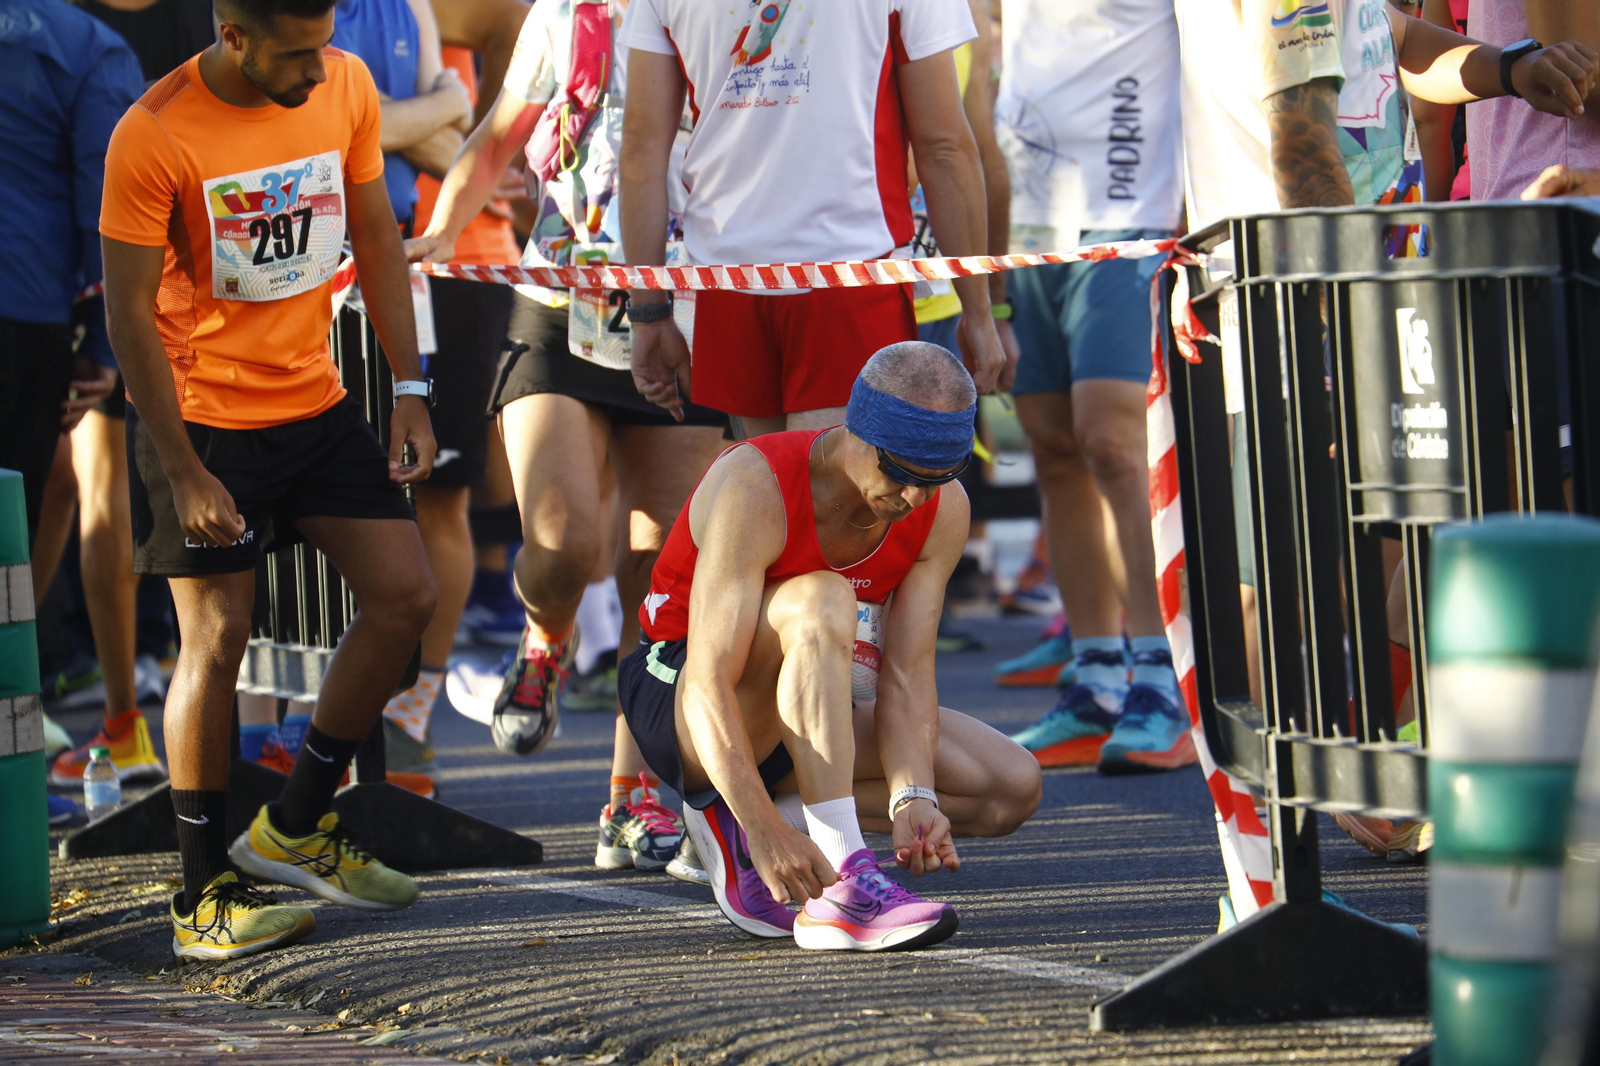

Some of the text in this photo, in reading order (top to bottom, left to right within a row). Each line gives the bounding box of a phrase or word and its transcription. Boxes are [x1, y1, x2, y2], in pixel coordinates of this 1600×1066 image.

[769, 74, 789, 87] más
[770, 54, 797, 72] hasta
[1107, 76, 1144, 200] PADRINO
[249, 207, 313, 266] 297
